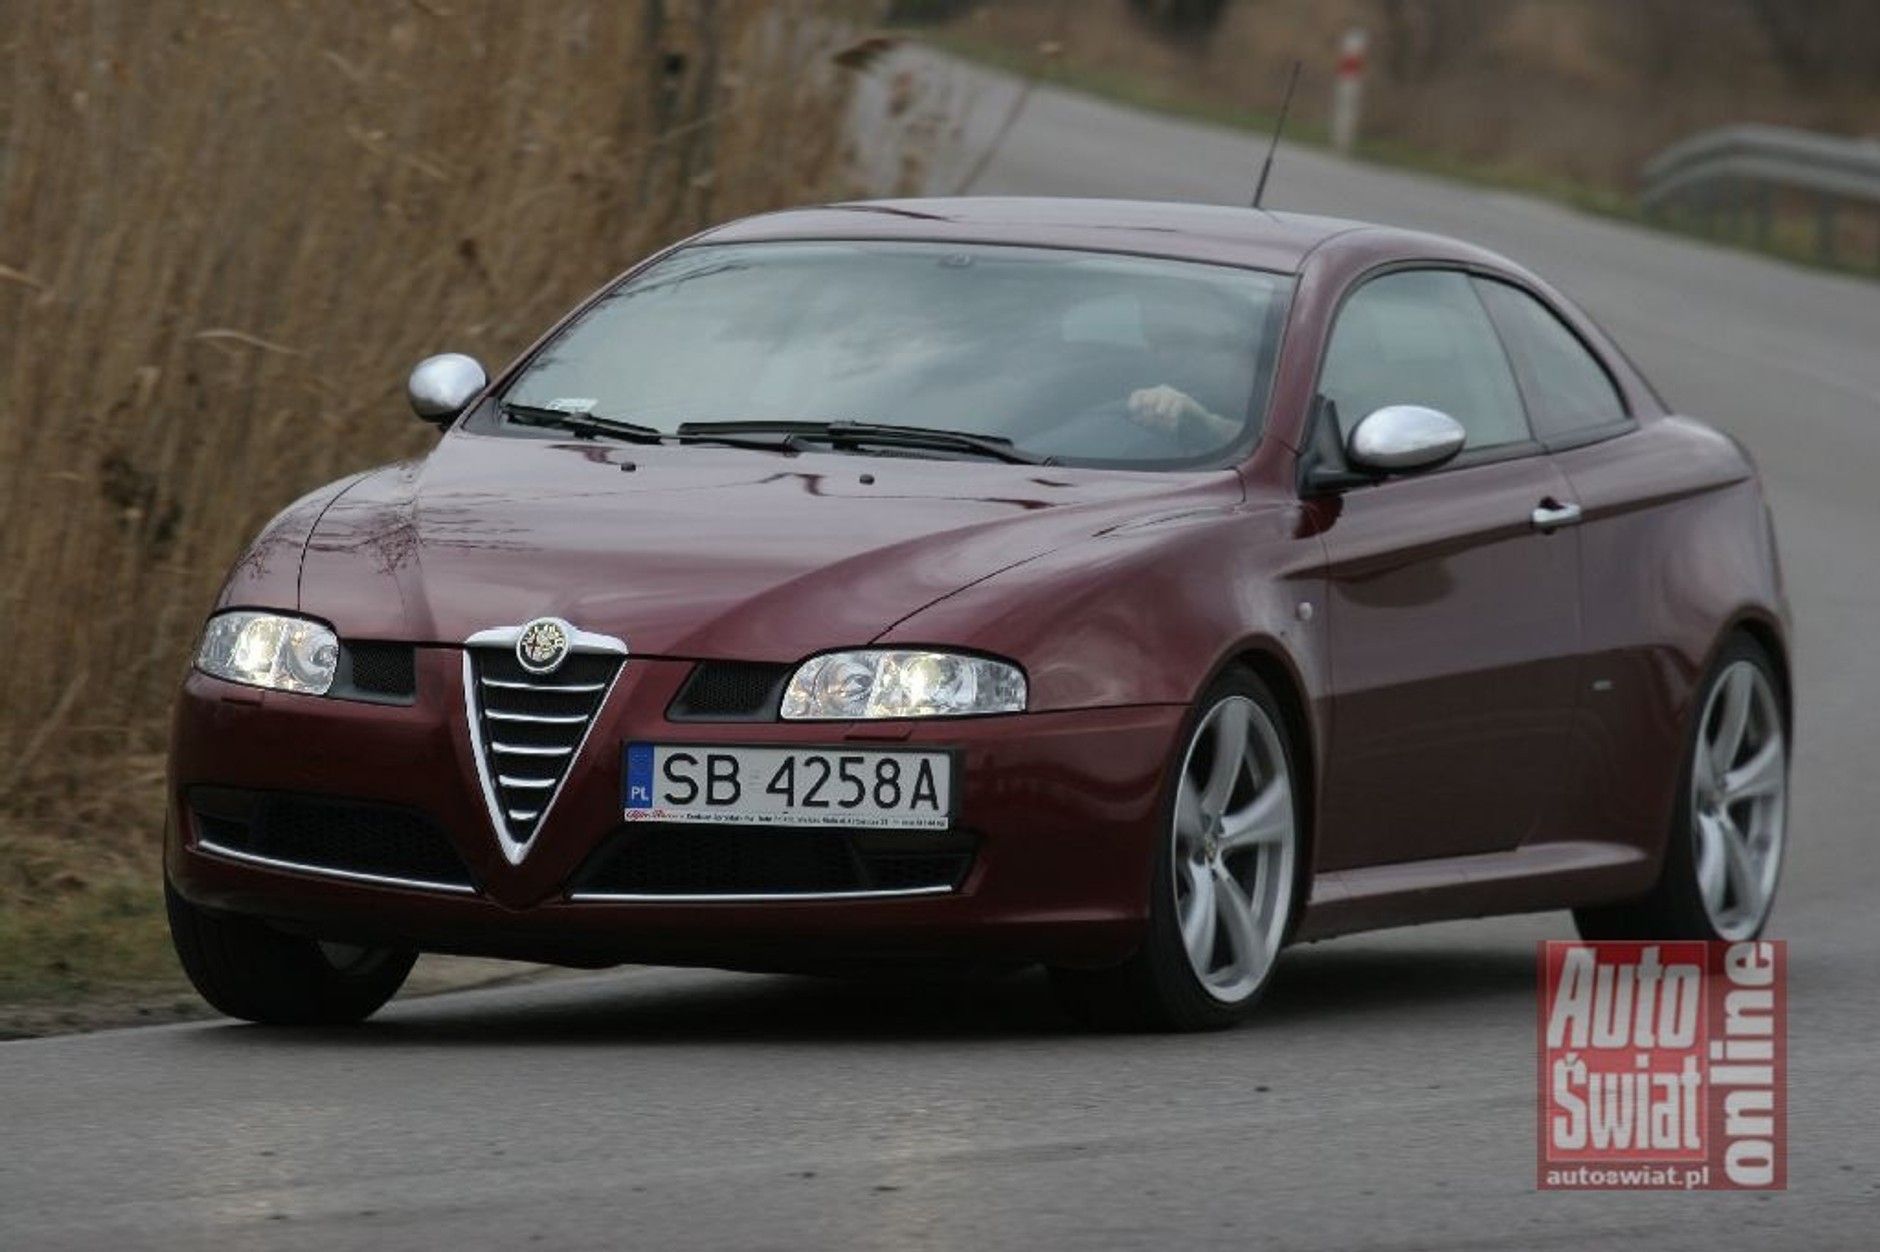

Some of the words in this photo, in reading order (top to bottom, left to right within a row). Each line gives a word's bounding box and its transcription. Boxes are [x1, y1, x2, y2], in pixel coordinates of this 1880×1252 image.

[631, 786, 649, 801] PL
[663, 753, 741, 806] SB
[766, 756, 940, 811] 4258A
